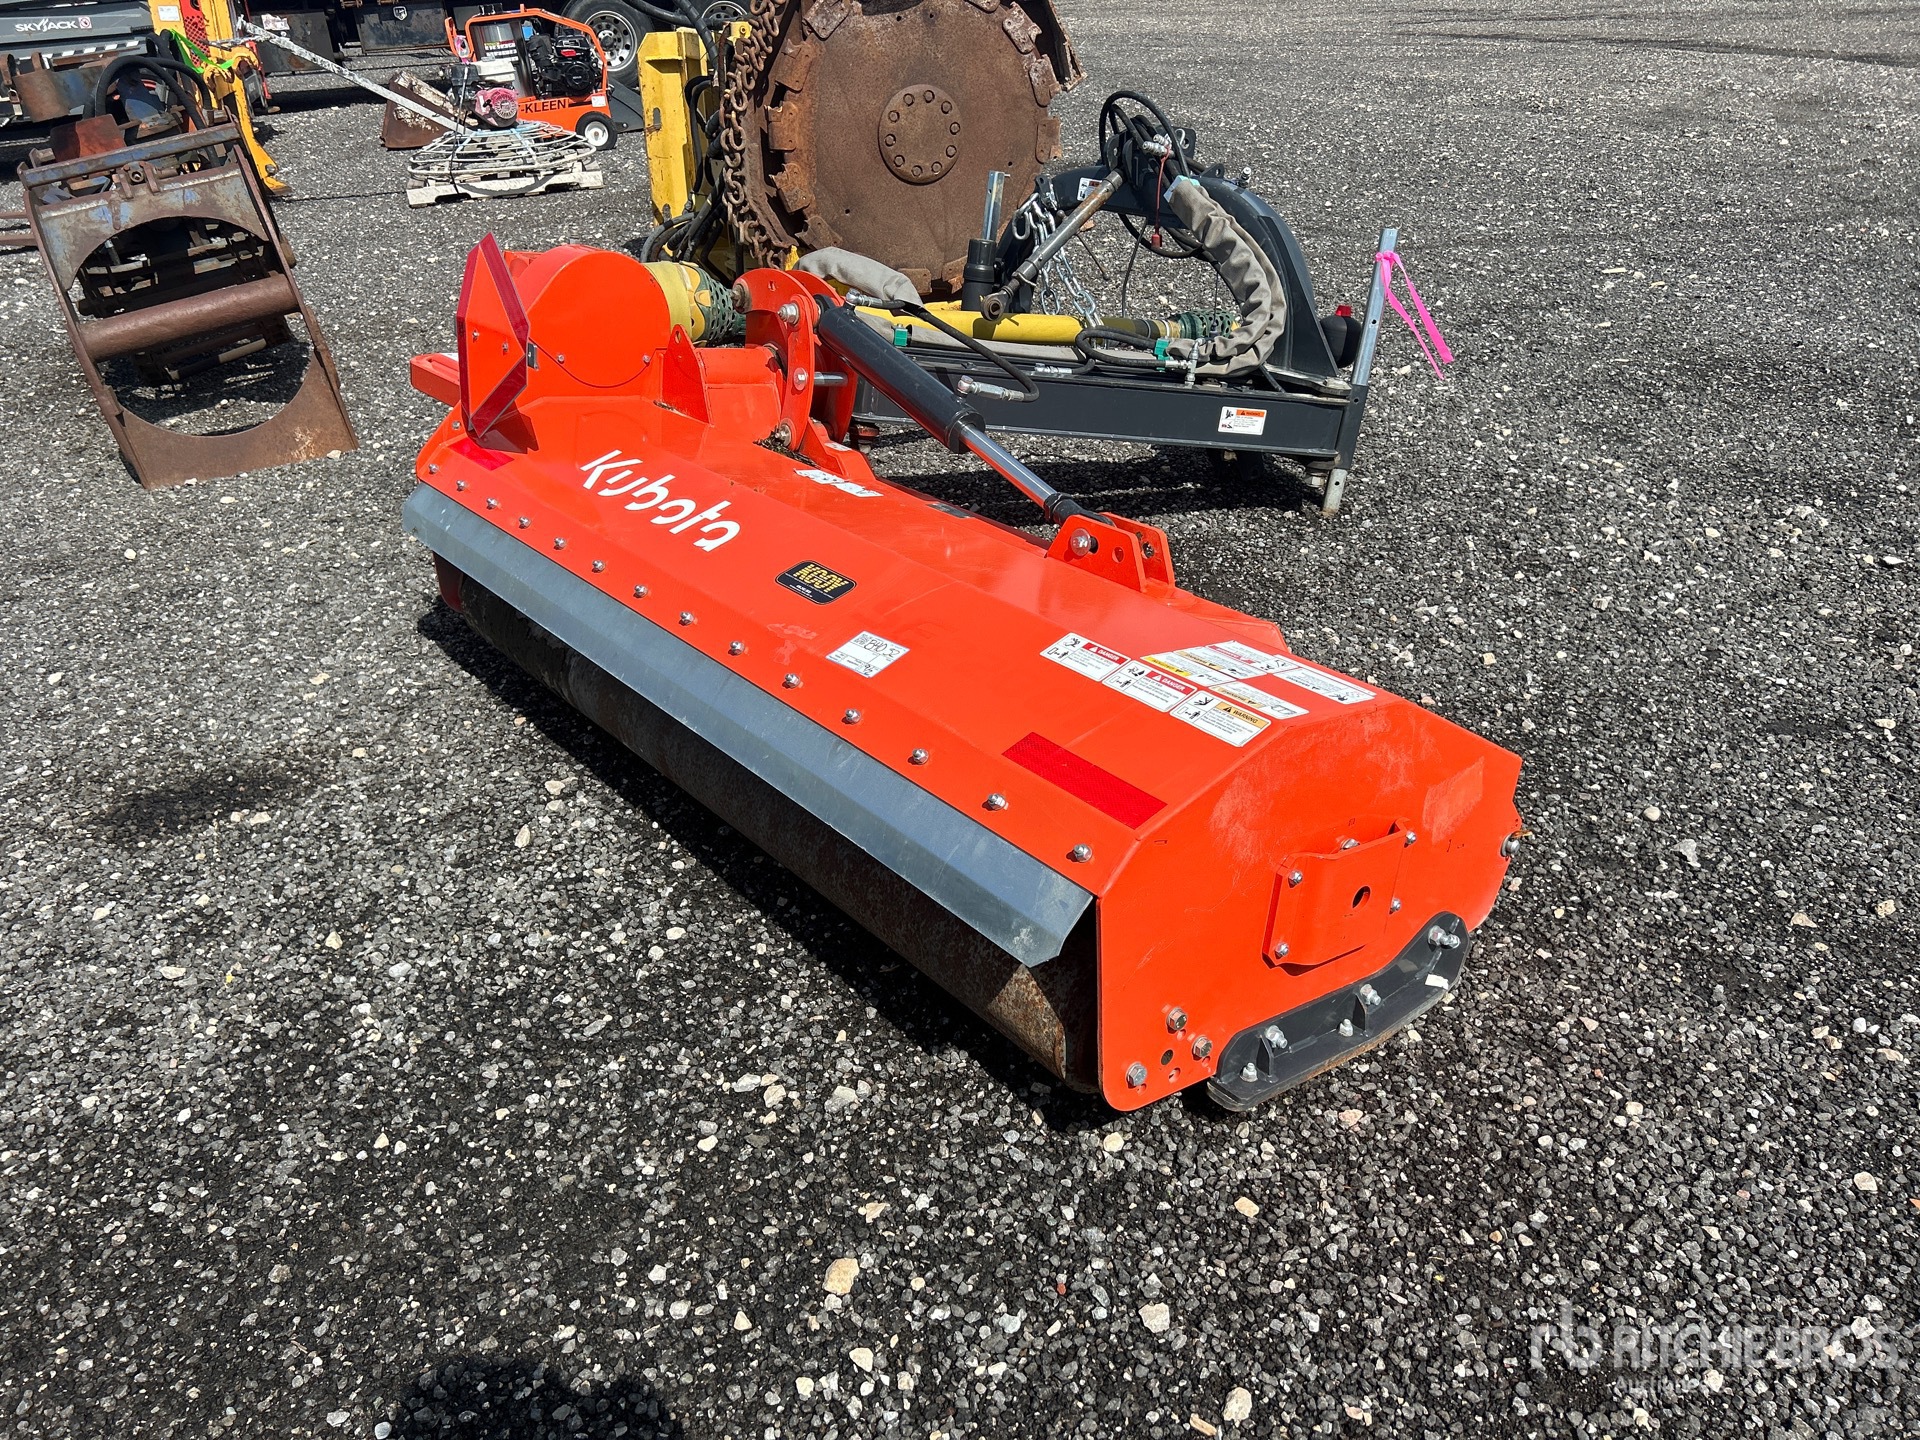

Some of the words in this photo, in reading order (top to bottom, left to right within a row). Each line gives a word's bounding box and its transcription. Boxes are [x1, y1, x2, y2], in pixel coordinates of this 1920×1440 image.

[15, 18, 79, 32] SKYJACK
[520, 100, 567, 113] -KLEEN
[579, 449, 741, 552] Kubota
[1098, 648, 1120, 662] DANGER
[1161, 677, 1186, 692] DANGER
[1232, 708, 1259, 724] WARNING
